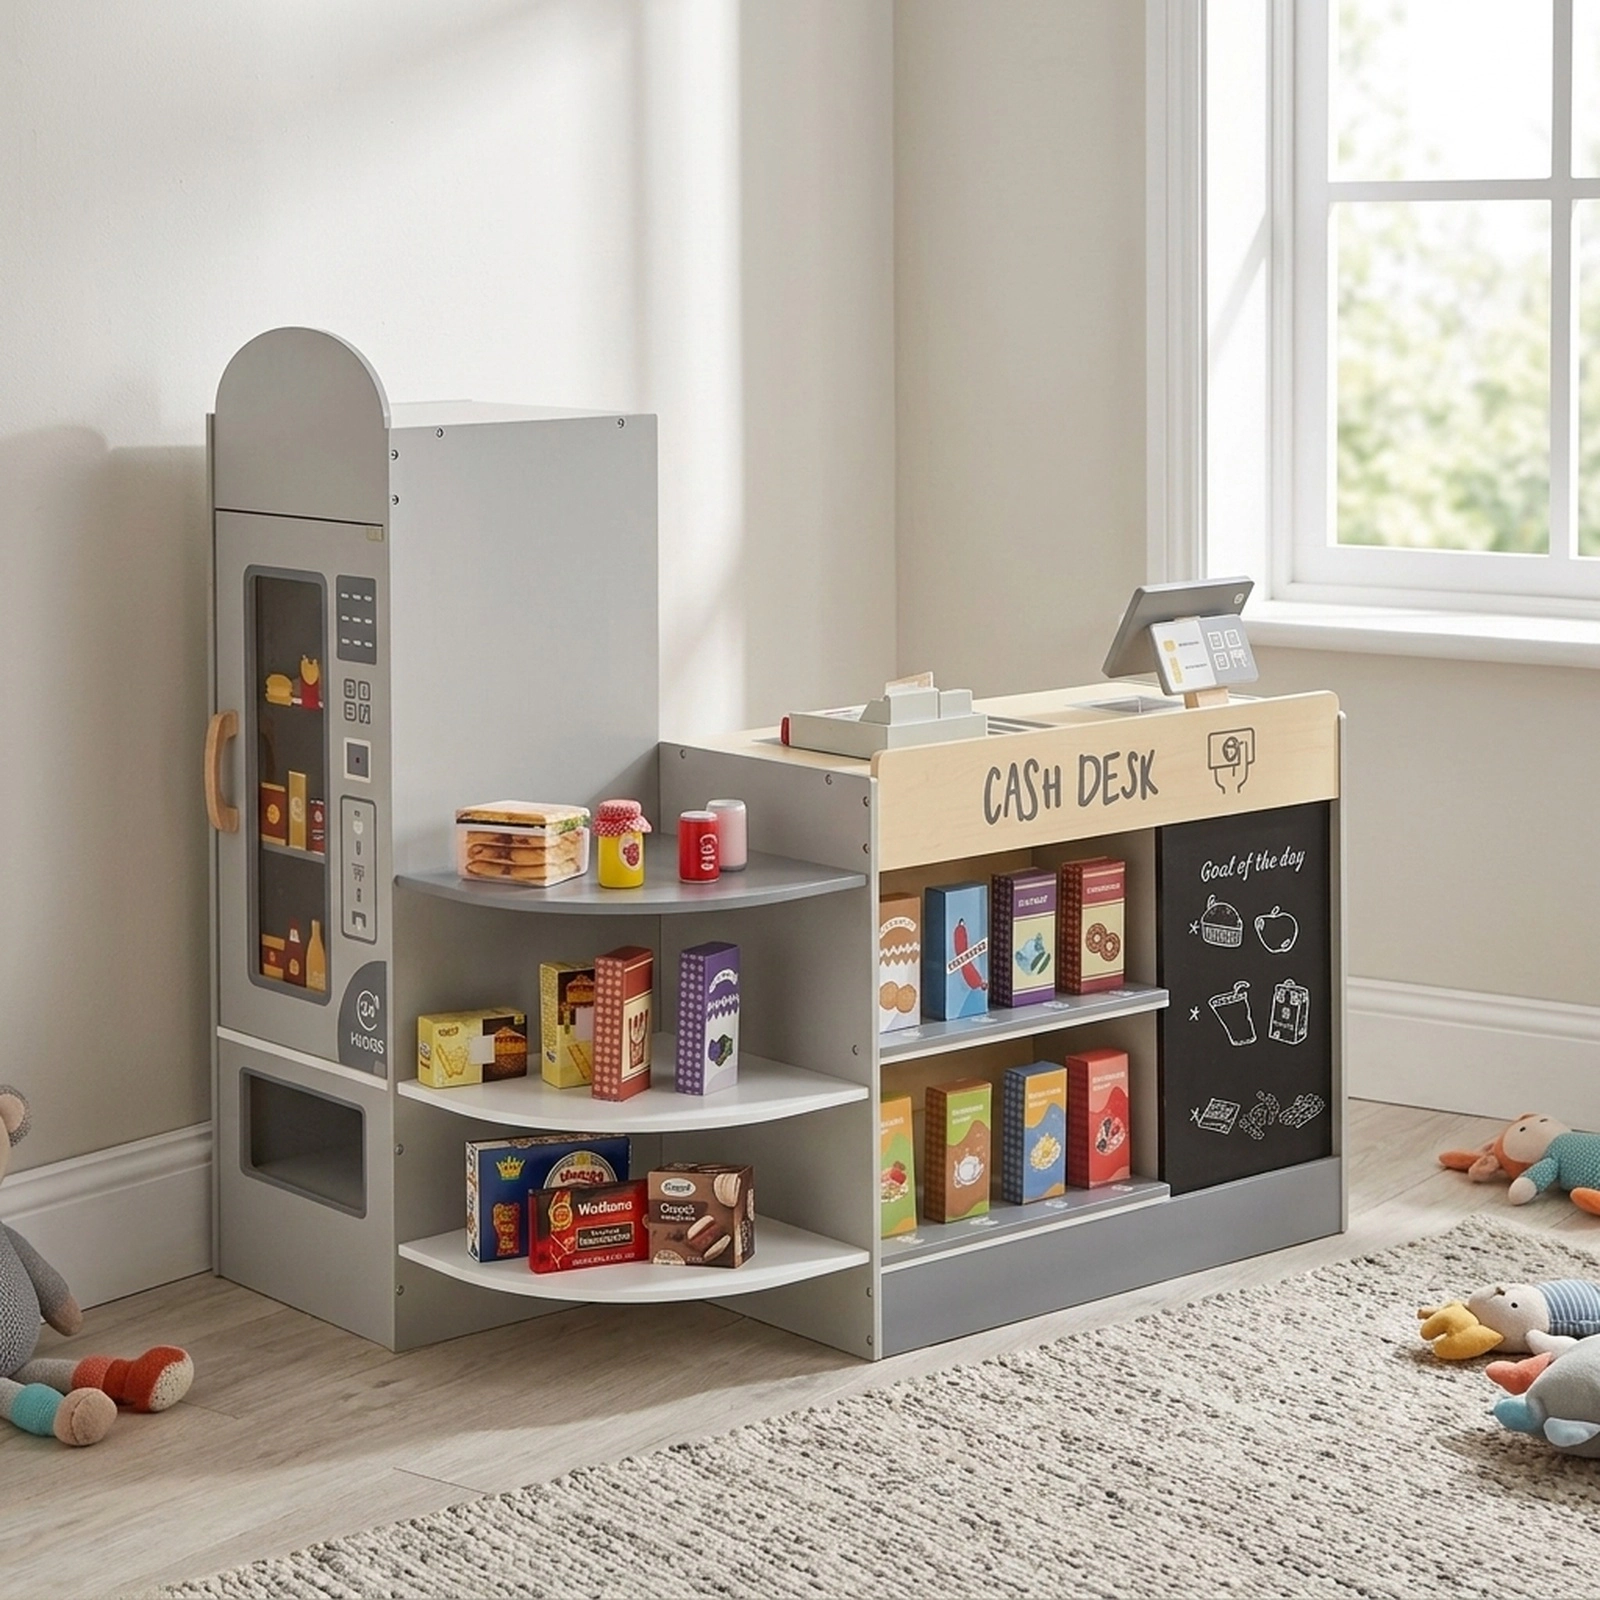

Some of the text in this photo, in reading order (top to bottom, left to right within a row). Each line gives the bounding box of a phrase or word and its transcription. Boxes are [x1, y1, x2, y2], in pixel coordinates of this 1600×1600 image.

[984, 749, 1159, 825] CASH DESK
[1200, 855, 1236, 883] Goal
[1255, 849, 1278, 872] the
